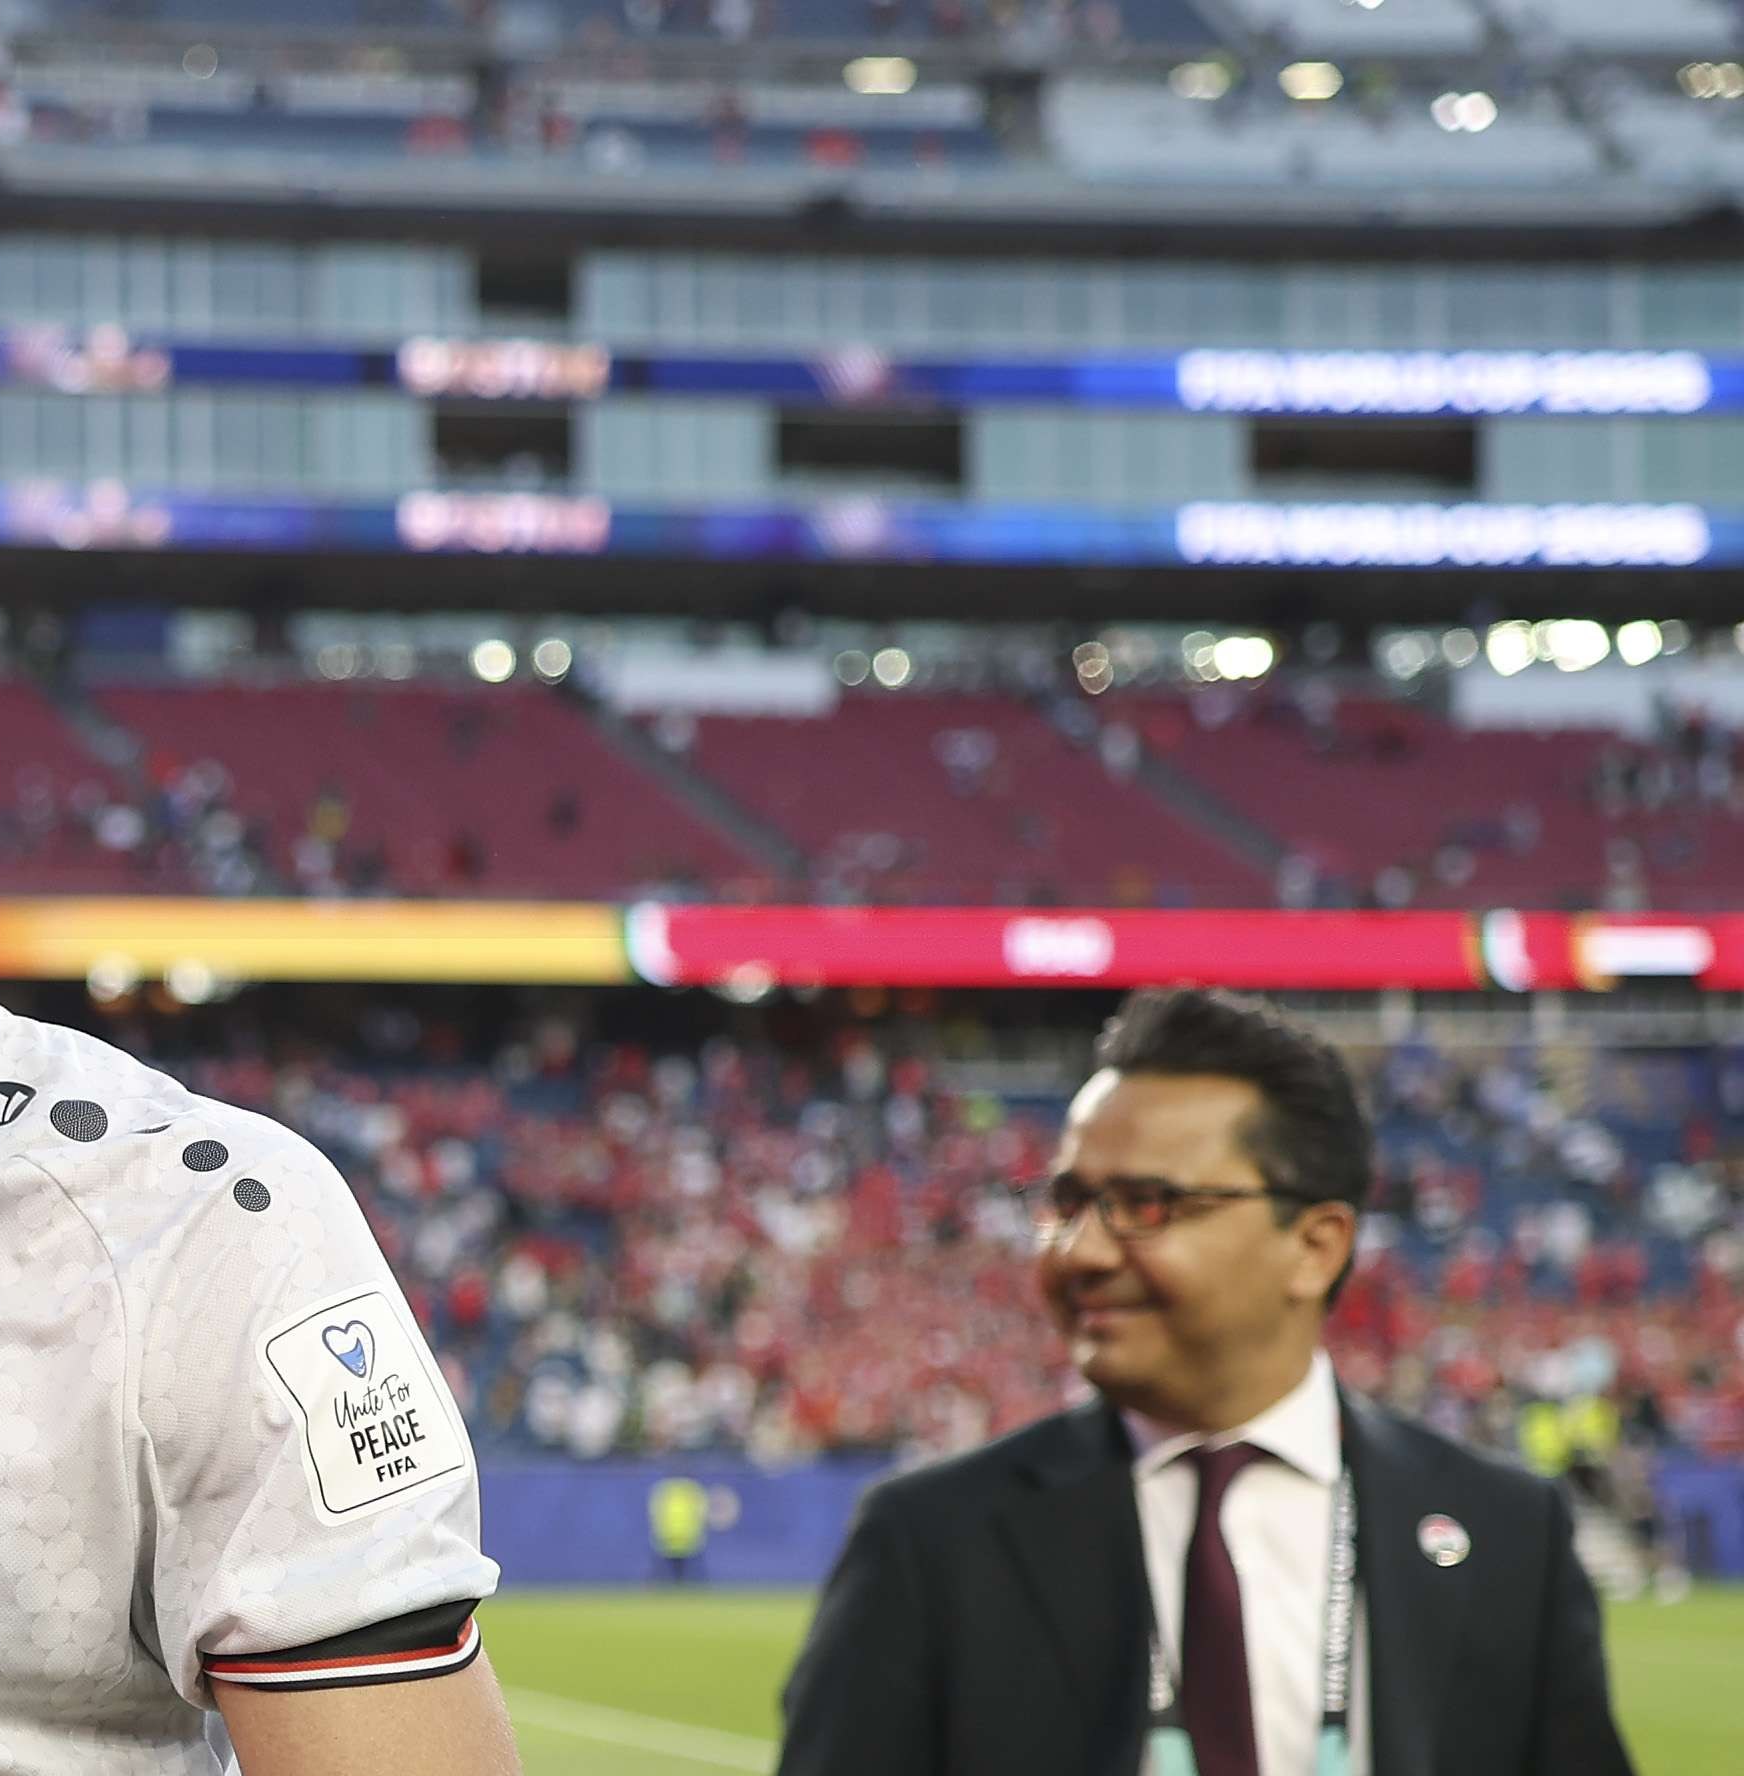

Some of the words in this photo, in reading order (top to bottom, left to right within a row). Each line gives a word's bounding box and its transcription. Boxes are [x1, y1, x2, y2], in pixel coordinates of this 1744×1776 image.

[334, 1386, 383, 1429] Unite
[380, 1374, 410, 1410] For
[350, 1409, 425, 1465] PEACE
[376, 1456, 417, 1482] FIFA
